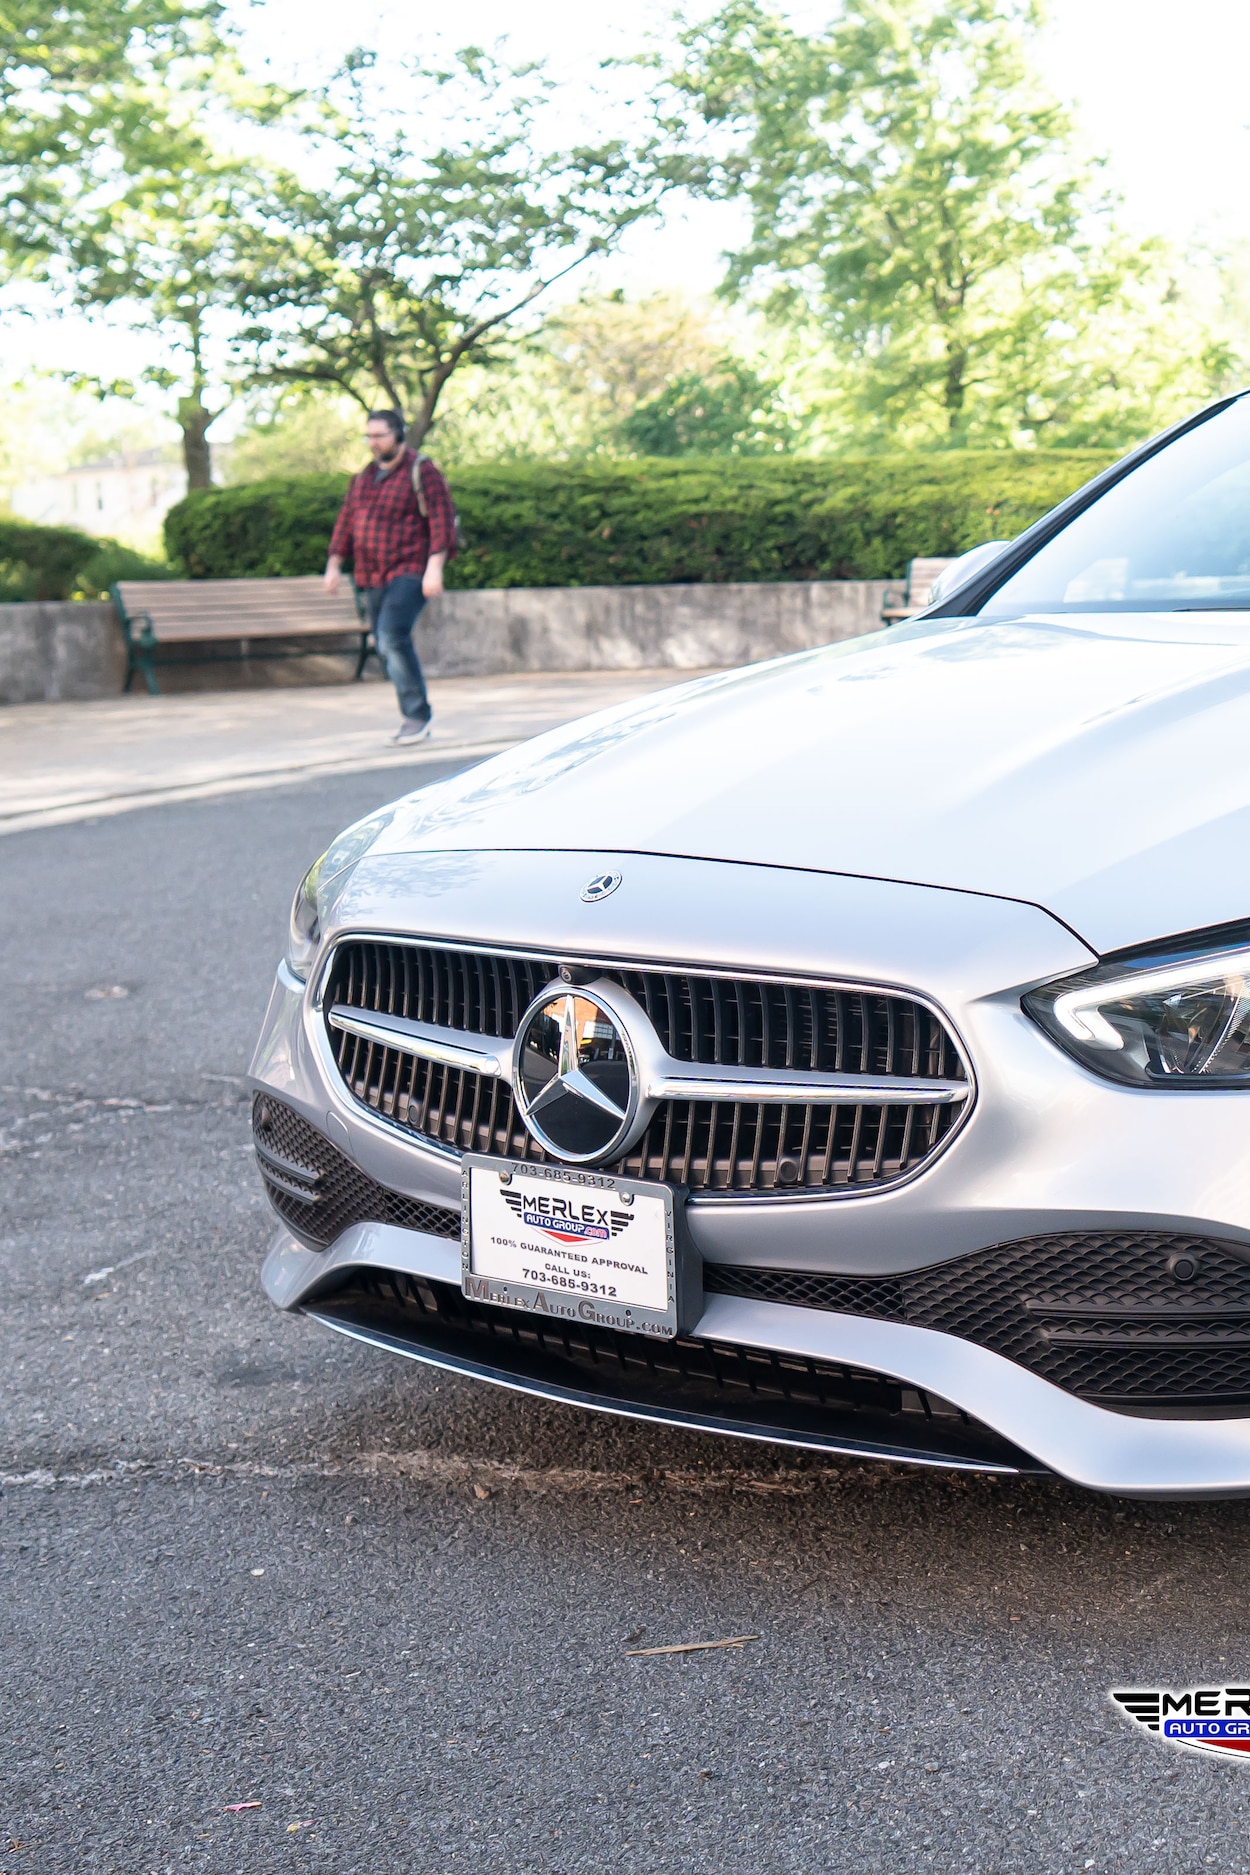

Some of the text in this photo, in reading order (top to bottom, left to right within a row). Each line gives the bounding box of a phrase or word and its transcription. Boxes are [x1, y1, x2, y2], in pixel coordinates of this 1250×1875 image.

[511, 1162, 617, 1190] 703-685-9312
[461, 1170, 469, 1272] ARLINGTON
[523, 1194, 609, 1226] MERLEX
[526, 1214, 552, 1228] AUTO
[490, 1236, 648, 1275] 100% GUARANTEED APPROVAL
[544, 1262, 591, 1279] CALL US:
[664, 1210, 675, 1304] VIRGINIA
[522, 1268, 617, 1297] 703-685-9312
